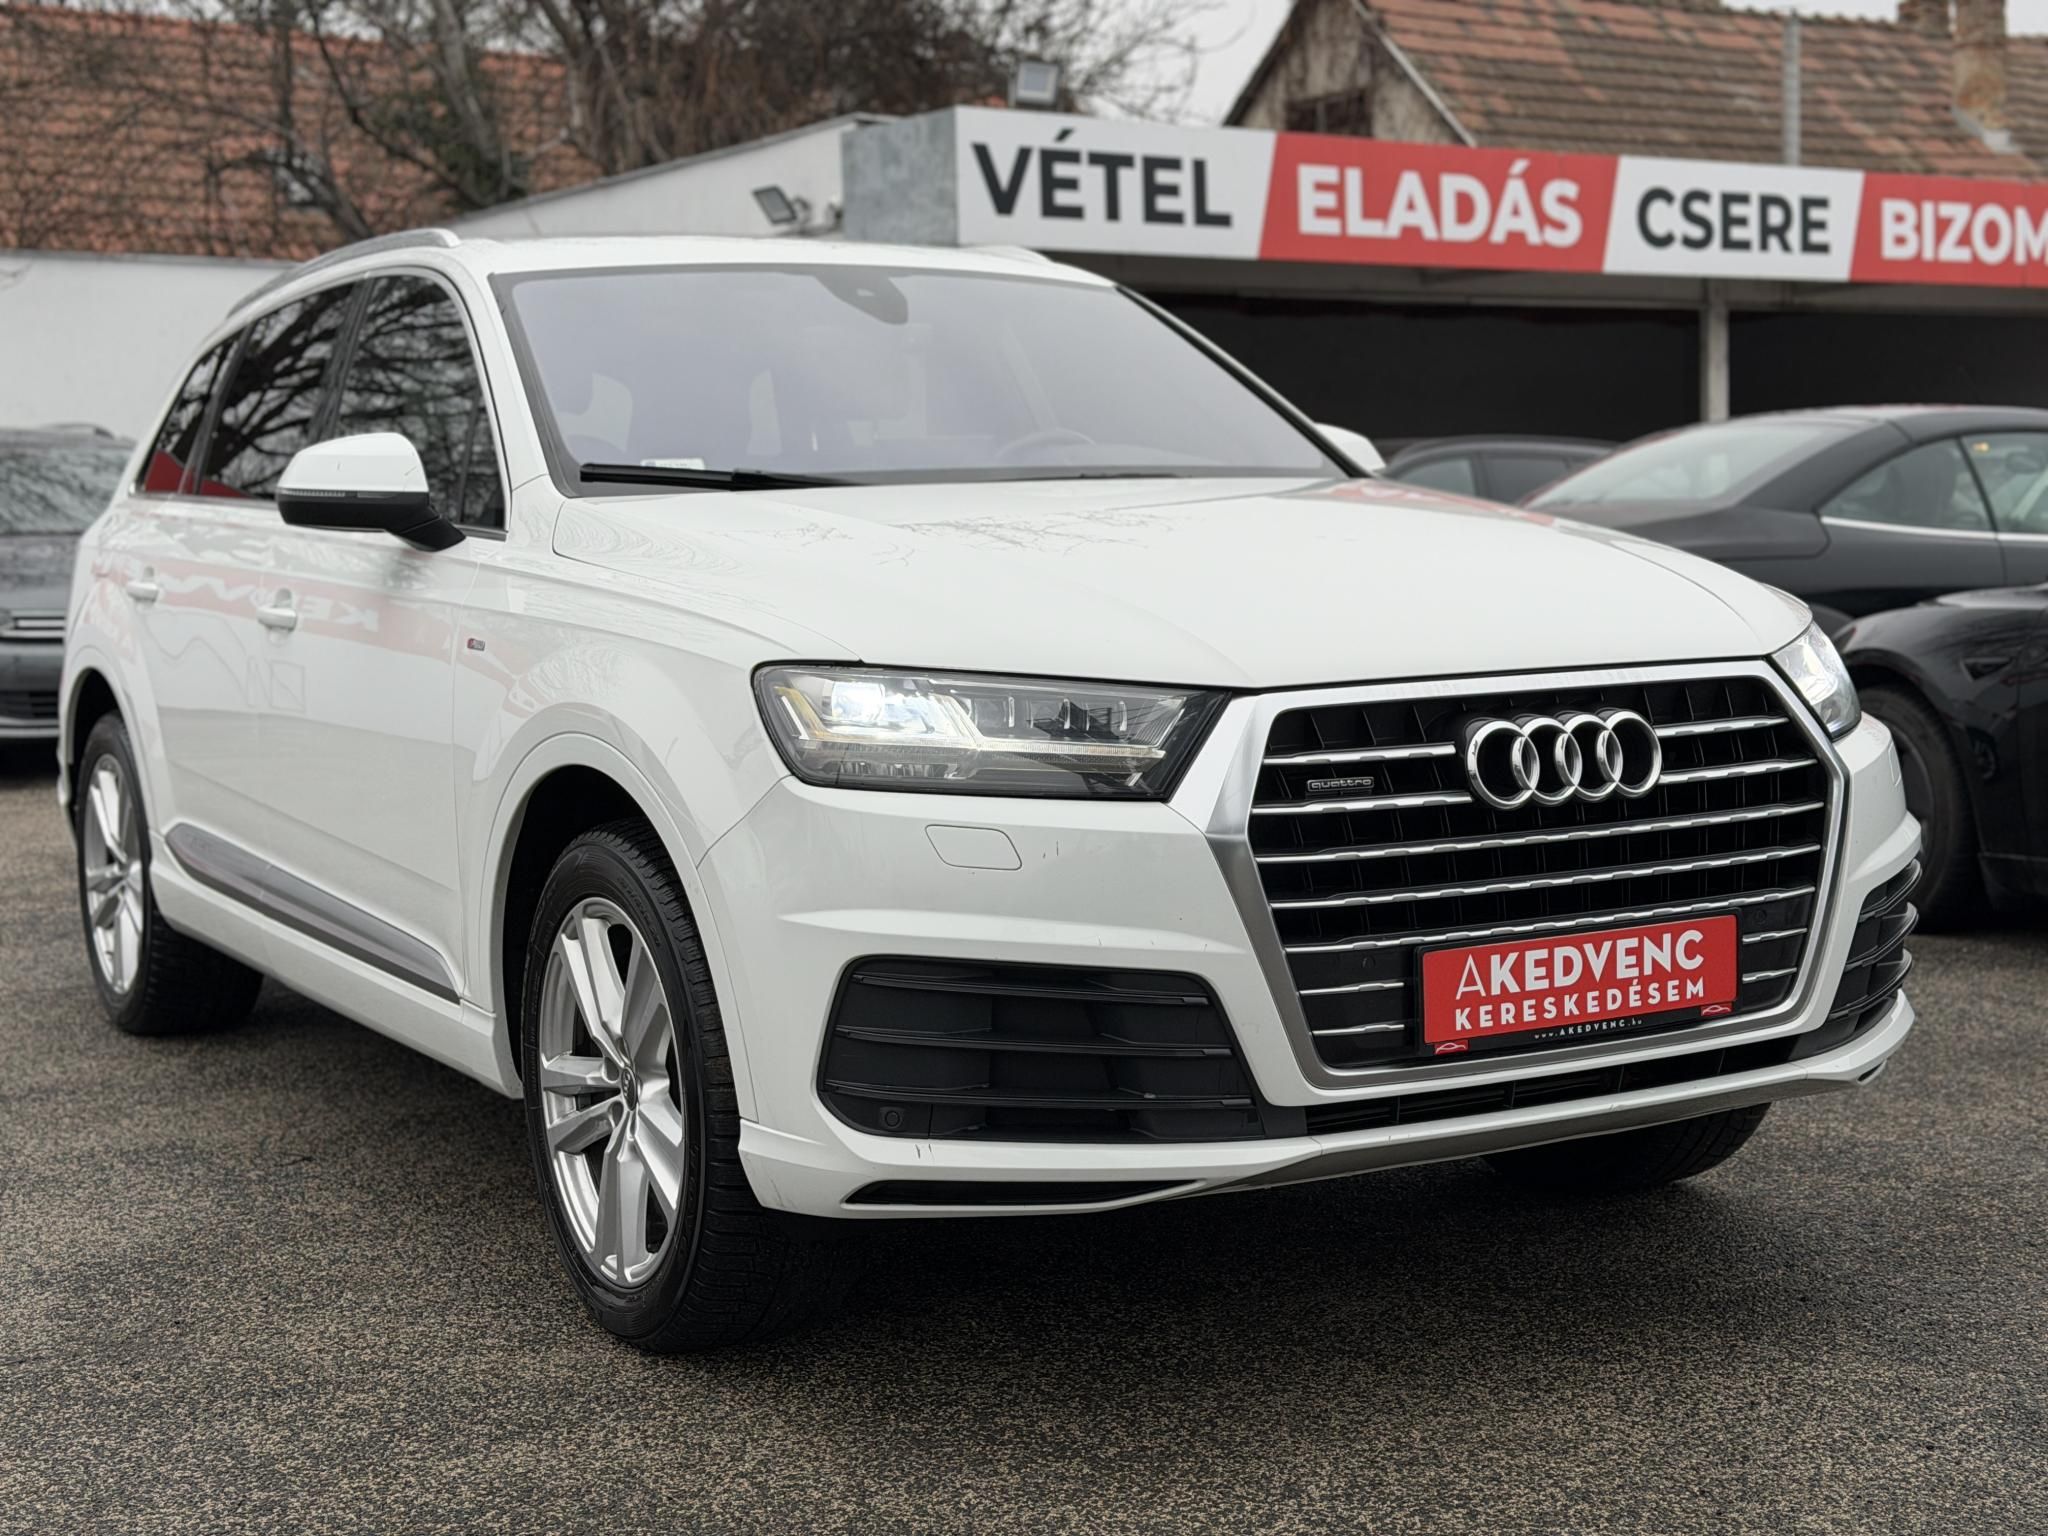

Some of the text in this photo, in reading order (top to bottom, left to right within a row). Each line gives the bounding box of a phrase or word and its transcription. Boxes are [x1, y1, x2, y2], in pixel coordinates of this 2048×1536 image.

[971, 128, 2048, 267] VÉTEL ELADÁS CSERE BIZOM
[1311, 778, 1372, 790] quattro
[1455, 929, 1704, 1000] AKEDVENC
[1455, 976, 1704, 1031] KERESKEDÉSEM
